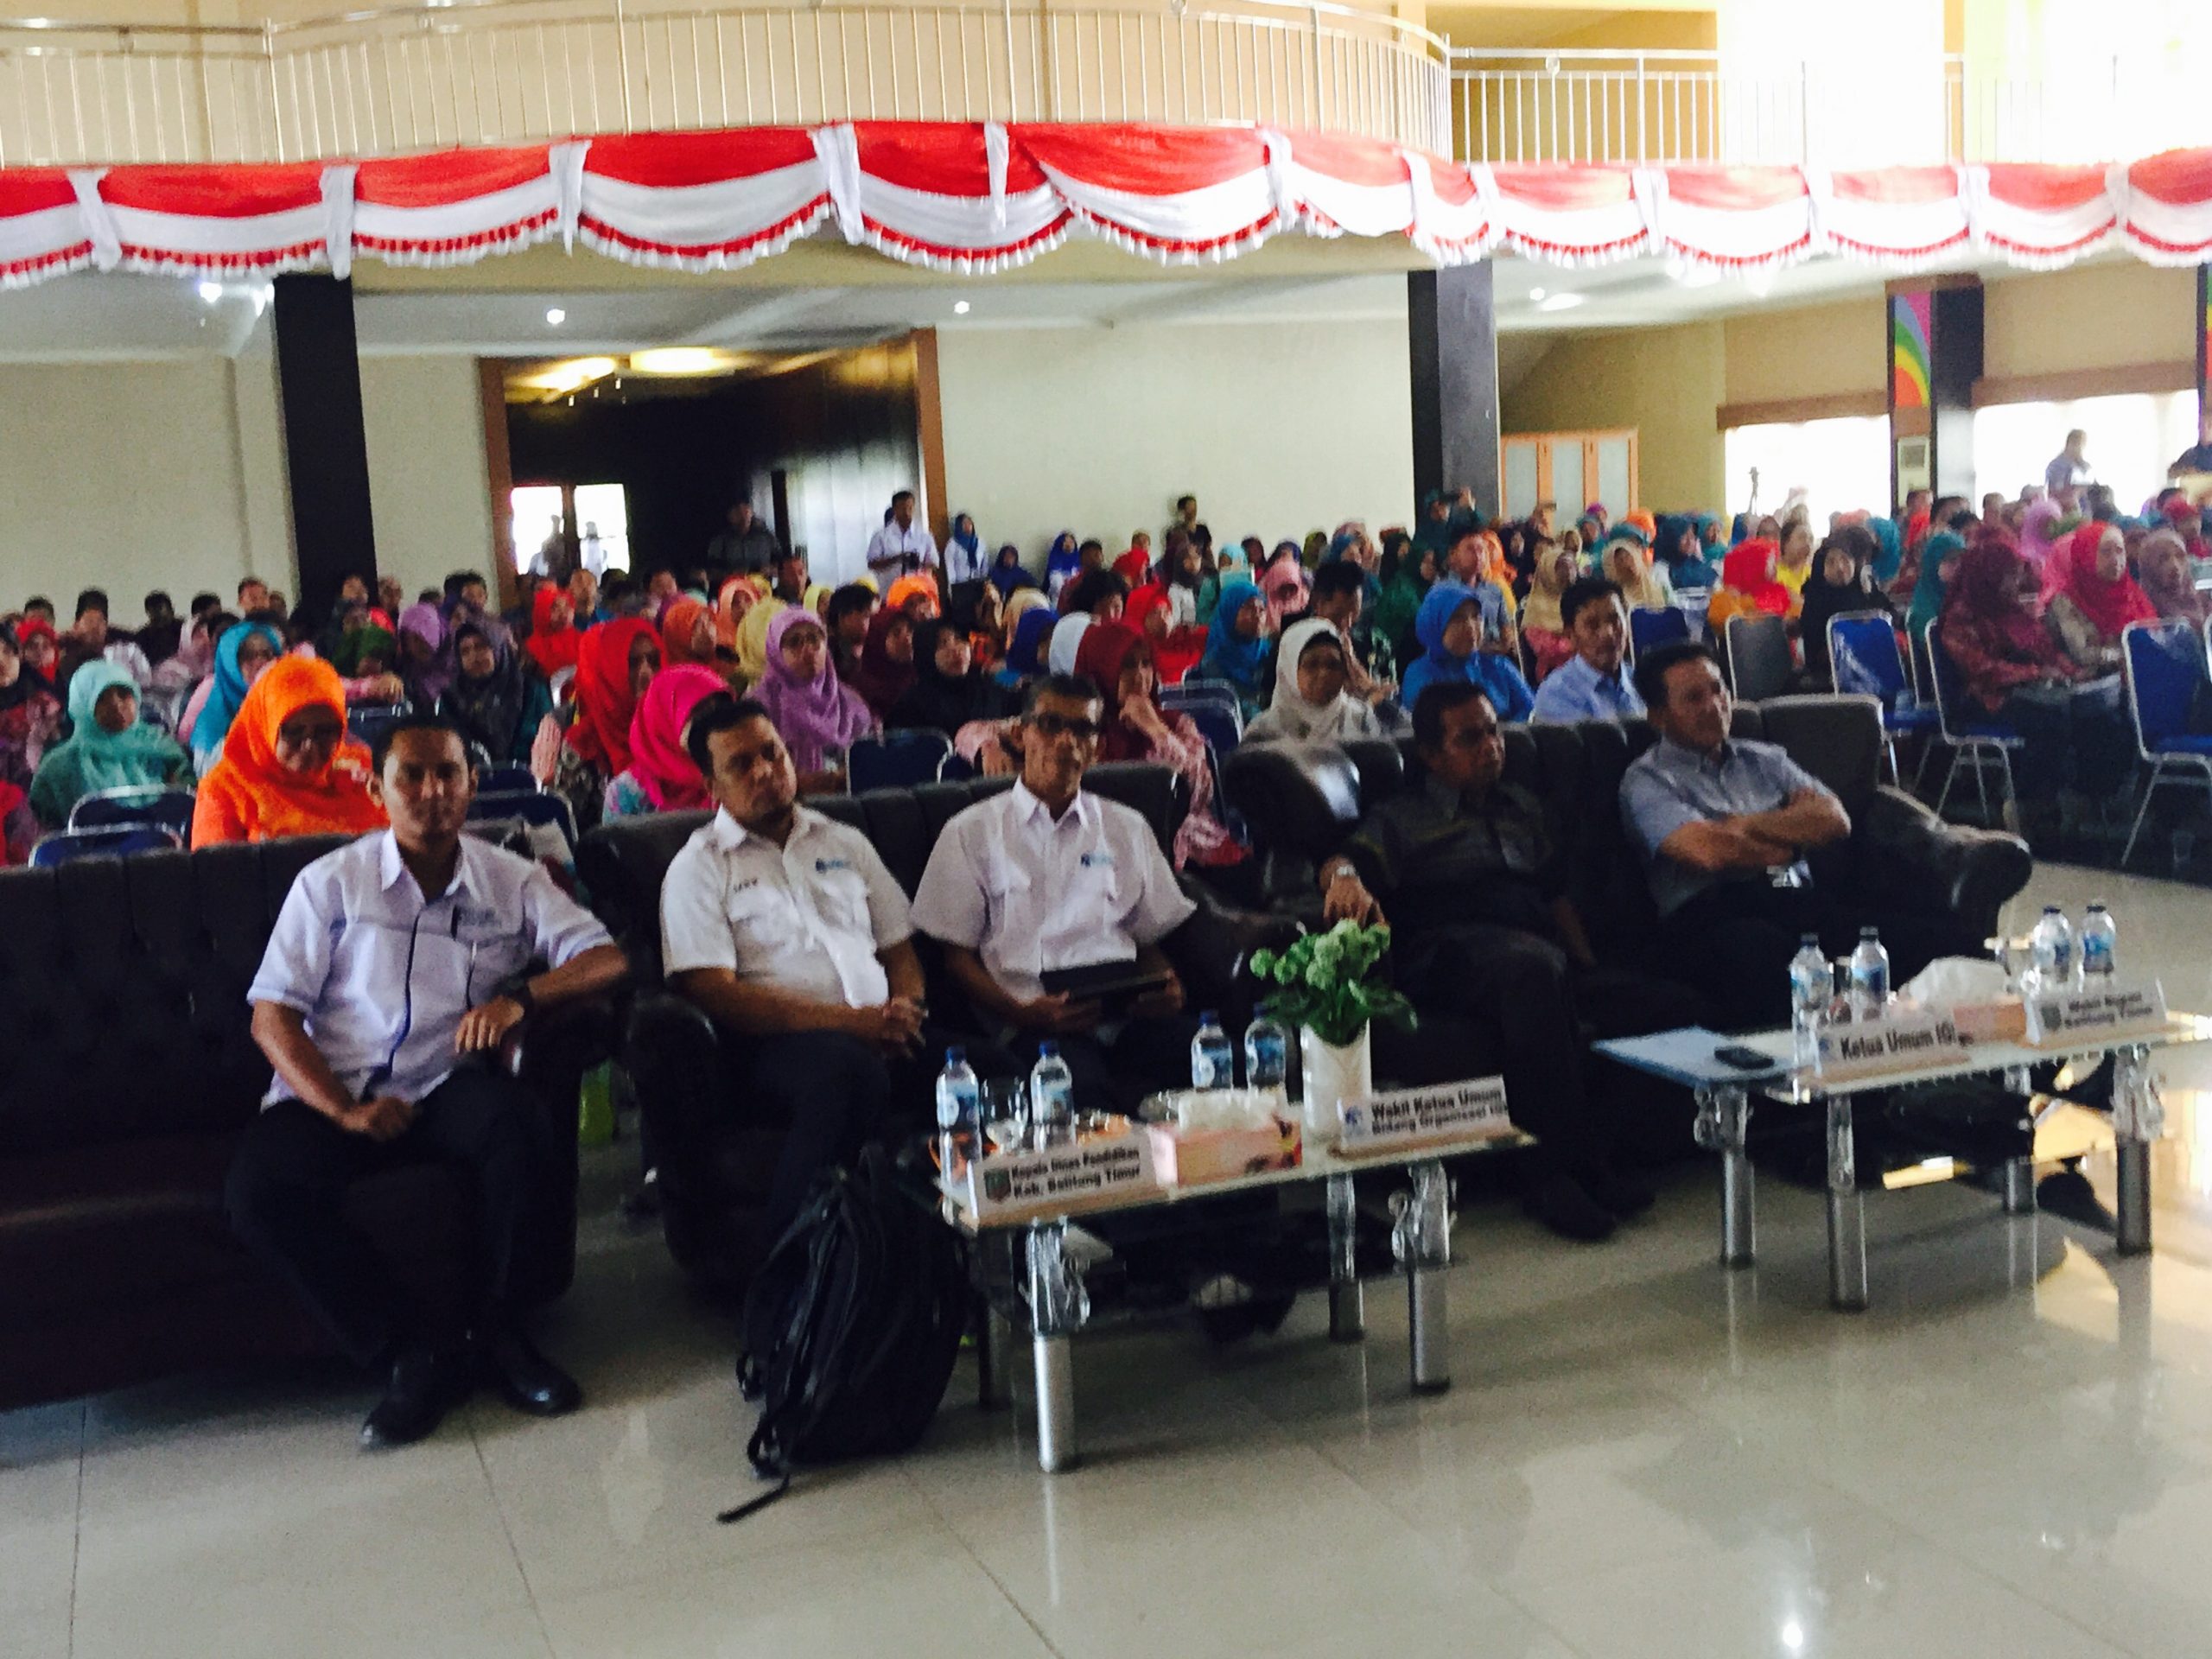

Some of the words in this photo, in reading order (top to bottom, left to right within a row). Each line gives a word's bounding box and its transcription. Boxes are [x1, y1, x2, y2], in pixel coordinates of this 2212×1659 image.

[1840, 1036, 1884, 1059] Ketua
[1885, 1028, 1934, 1052] Umum
[1106, 1165, 1140, 1183] Timur
